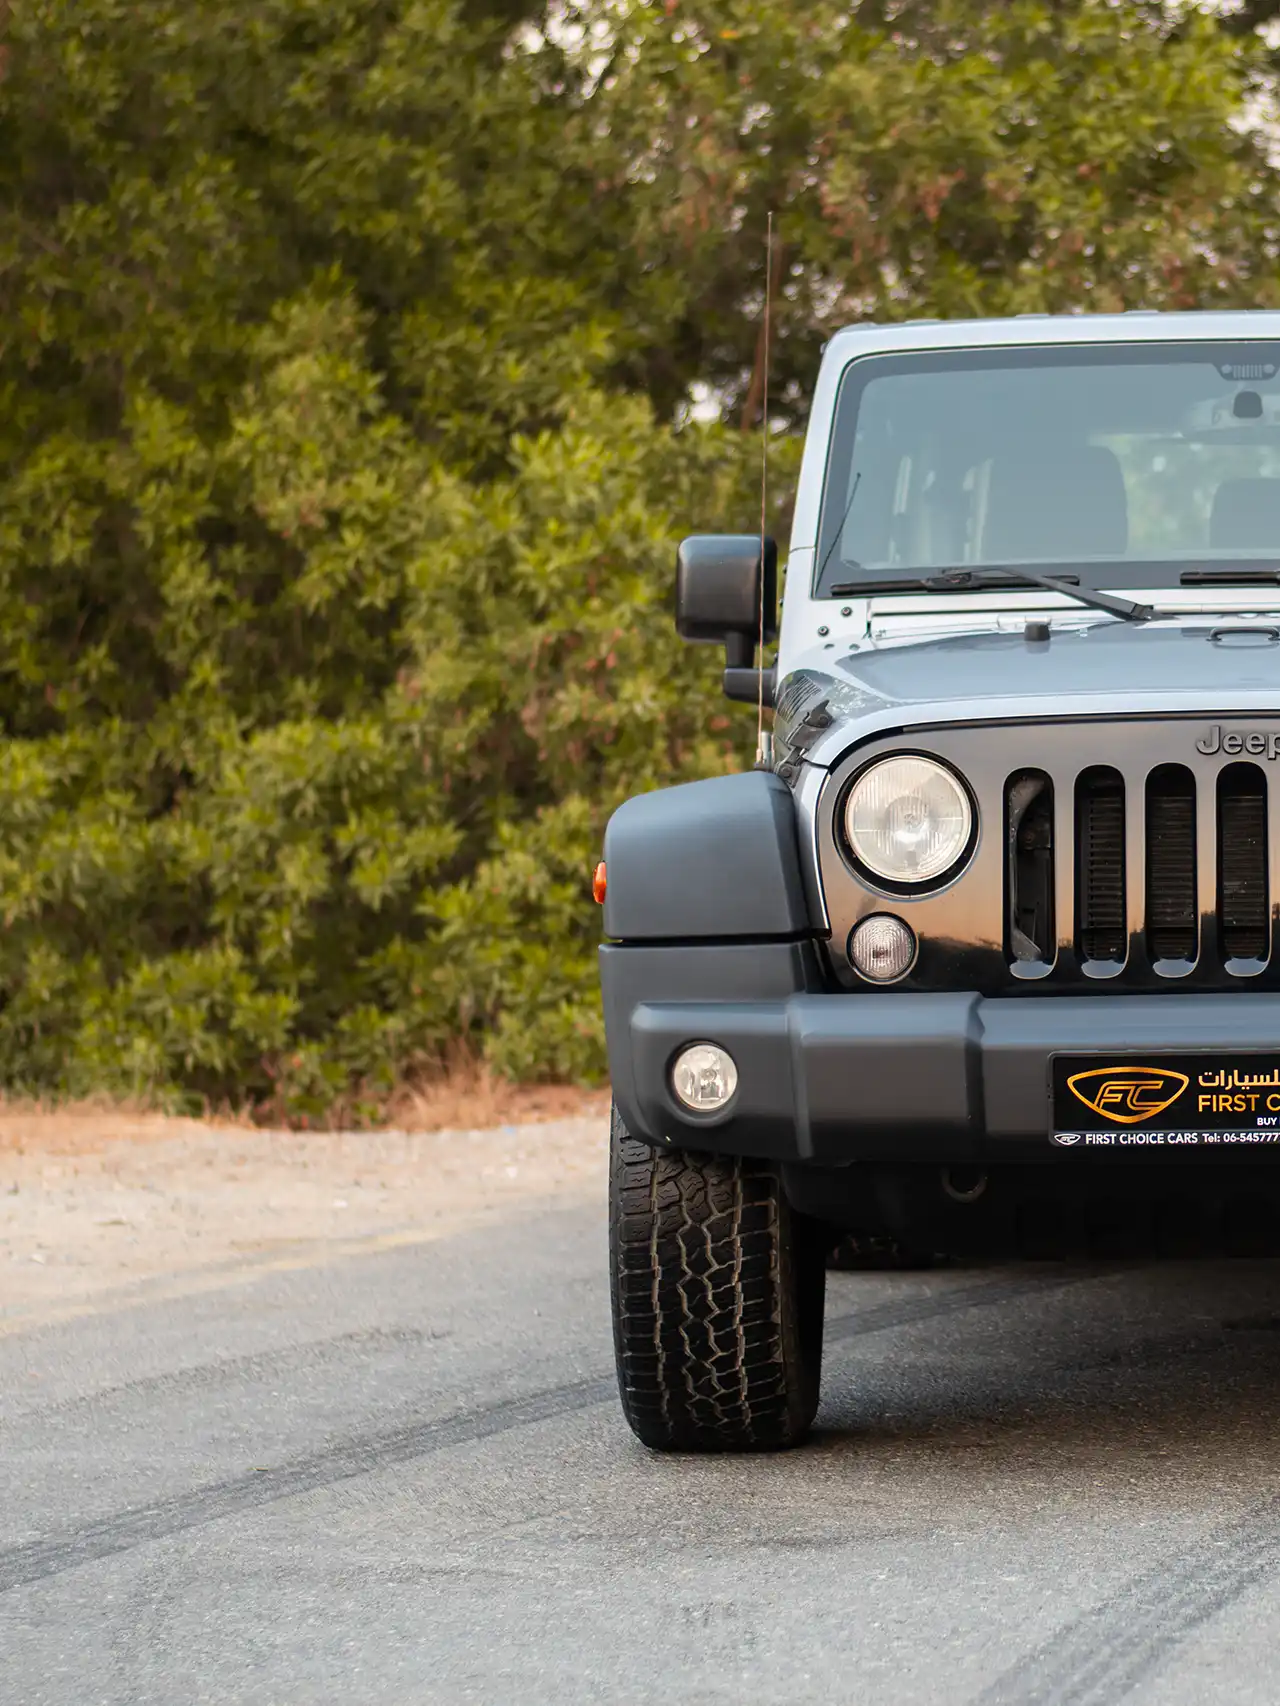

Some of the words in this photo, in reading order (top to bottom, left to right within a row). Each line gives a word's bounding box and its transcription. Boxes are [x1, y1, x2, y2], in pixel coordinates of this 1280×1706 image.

[1199, 1094, 1261, 1112] FIRST
[1256, 1117, 1278, 1126] BUY
[1085, 1133, 1117, 1145] FIRST
[1120, 1133, 1165, 1145] CHOICE
[1167, 1132, 1199, 1144] CARS
[1202, 1133, 1221, 1143] Tel:
